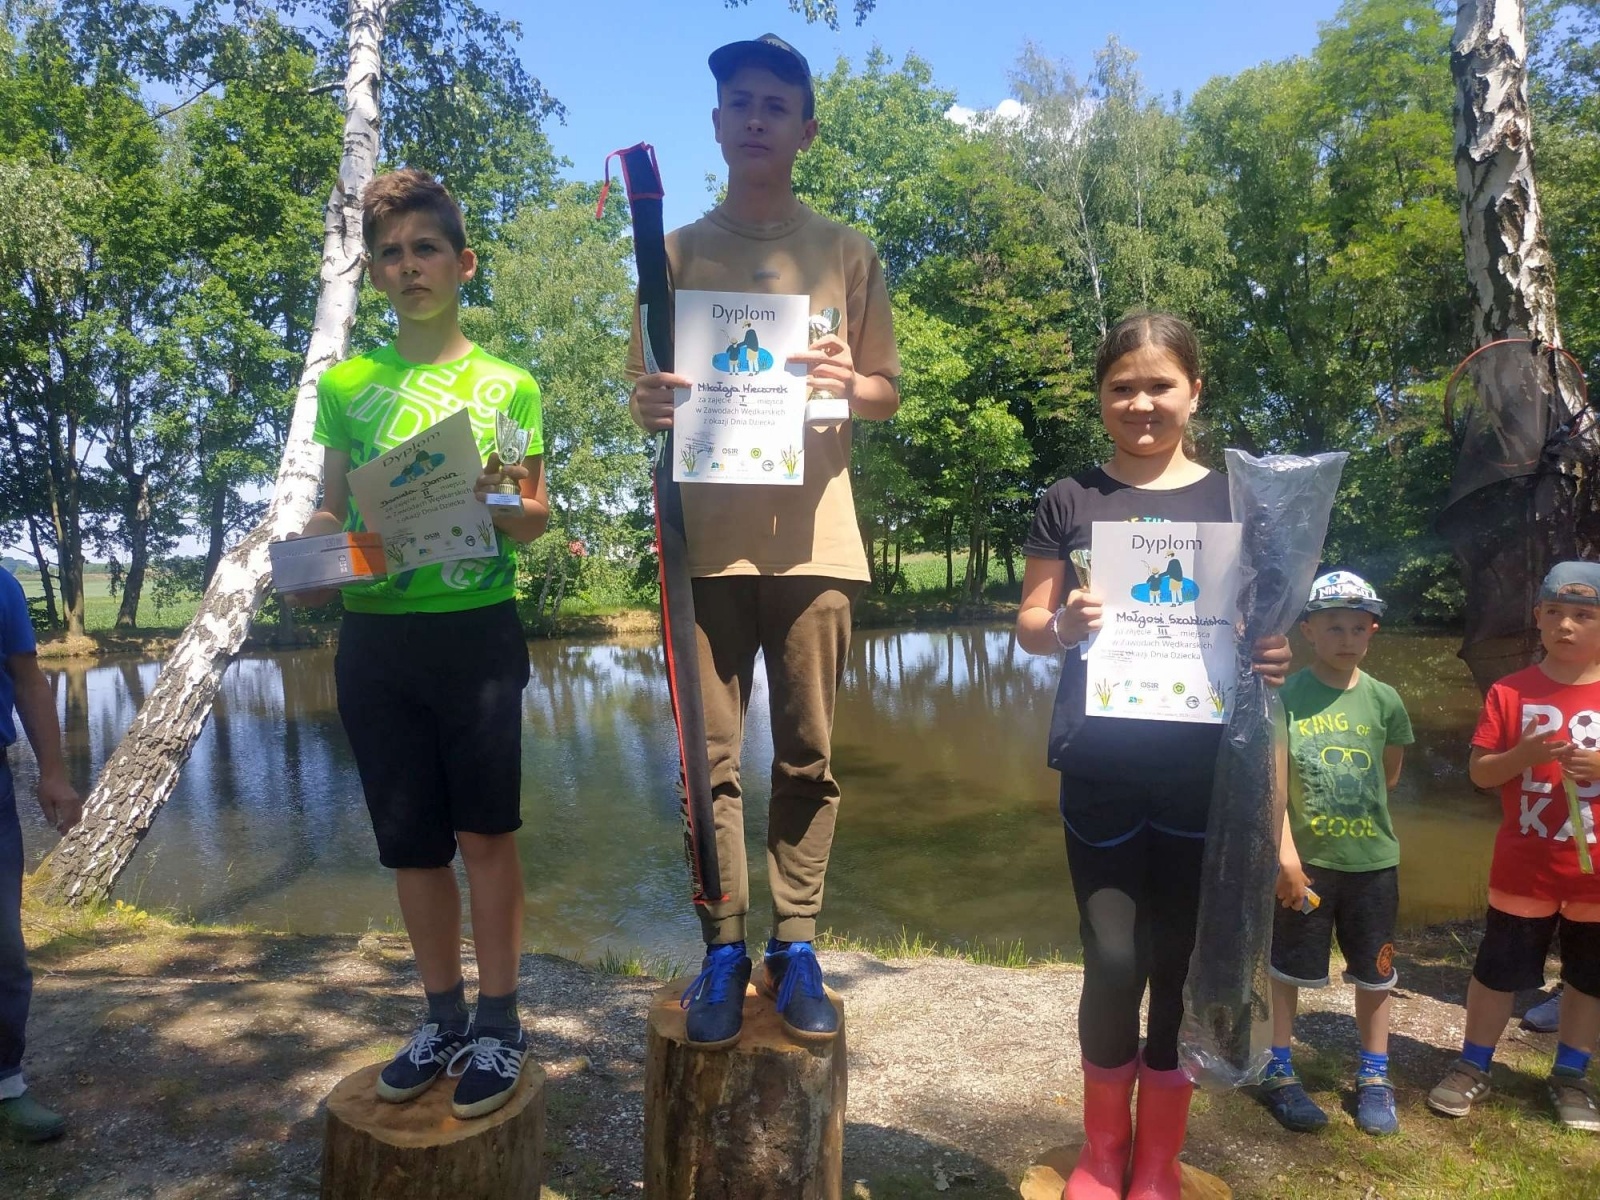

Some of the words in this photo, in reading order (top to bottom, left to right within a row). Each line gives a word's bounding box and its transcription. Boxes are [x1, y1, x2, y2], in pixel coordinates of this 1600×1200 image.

[711, 303, 776, 325] Dyplom
[707, 396, 731, 405] zajęcie
[757, 398, 784, 407] miejsca
[703, 406, 739, 415] Zawodach
[741, 407, 786, 416] Wędkarskich
[708, 418, 729, 427] okazji
[749, 418, 776, 426] Dziecka
[382, 431, 441, 468] Dyplom
[428, 487, 473, 504] Wędkarskich
[439, 498, 467, 511] Dziecka
[1131, 534, 1203, 554] Dyplom
[1180, 630, 1210, 639] miejsca
[1161, 640, 1213, 650] Wędkarskich
[1150, 650, 1168, 659] Dnia
[1170, 651, 1201, 660] Dziecka
[1298, 711, 1349, 737] KING
[1356, 724, 1370, 737] OF
[1310, 815, 1377, 838] COOL
